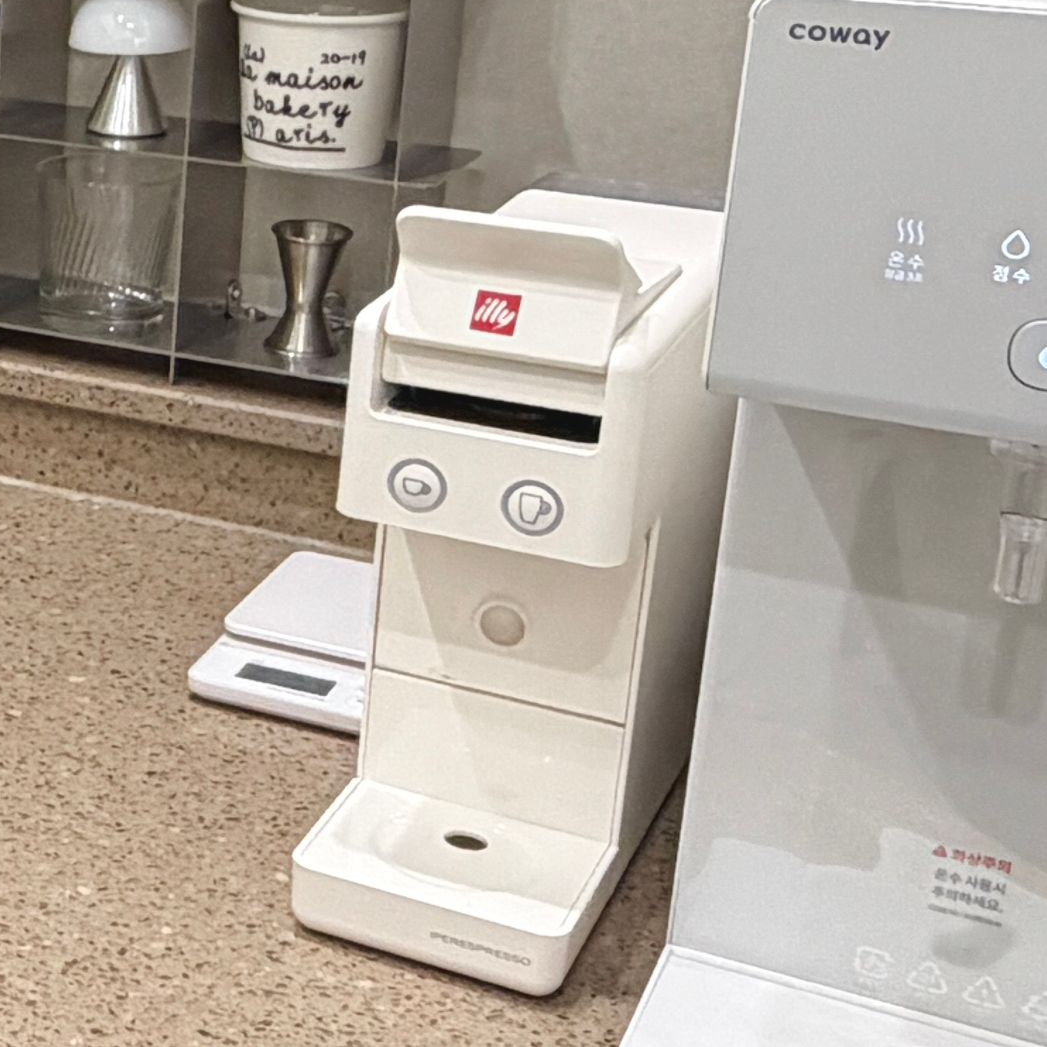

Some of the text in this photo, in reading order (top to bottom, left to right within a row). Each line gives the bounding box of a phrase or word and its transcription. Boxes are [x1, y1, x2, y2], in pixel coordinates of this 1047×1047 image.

[788, 23, 891, 50] coway
[320, 50, 367, 66] 20-19
[265, 67, 363, 91] maison
[253, 88, 351, 128] bakery
[888, 250, 925, 270] 온수
[992, 264, 1031, 284] 정수
[474, 297, 516, 330] illy
